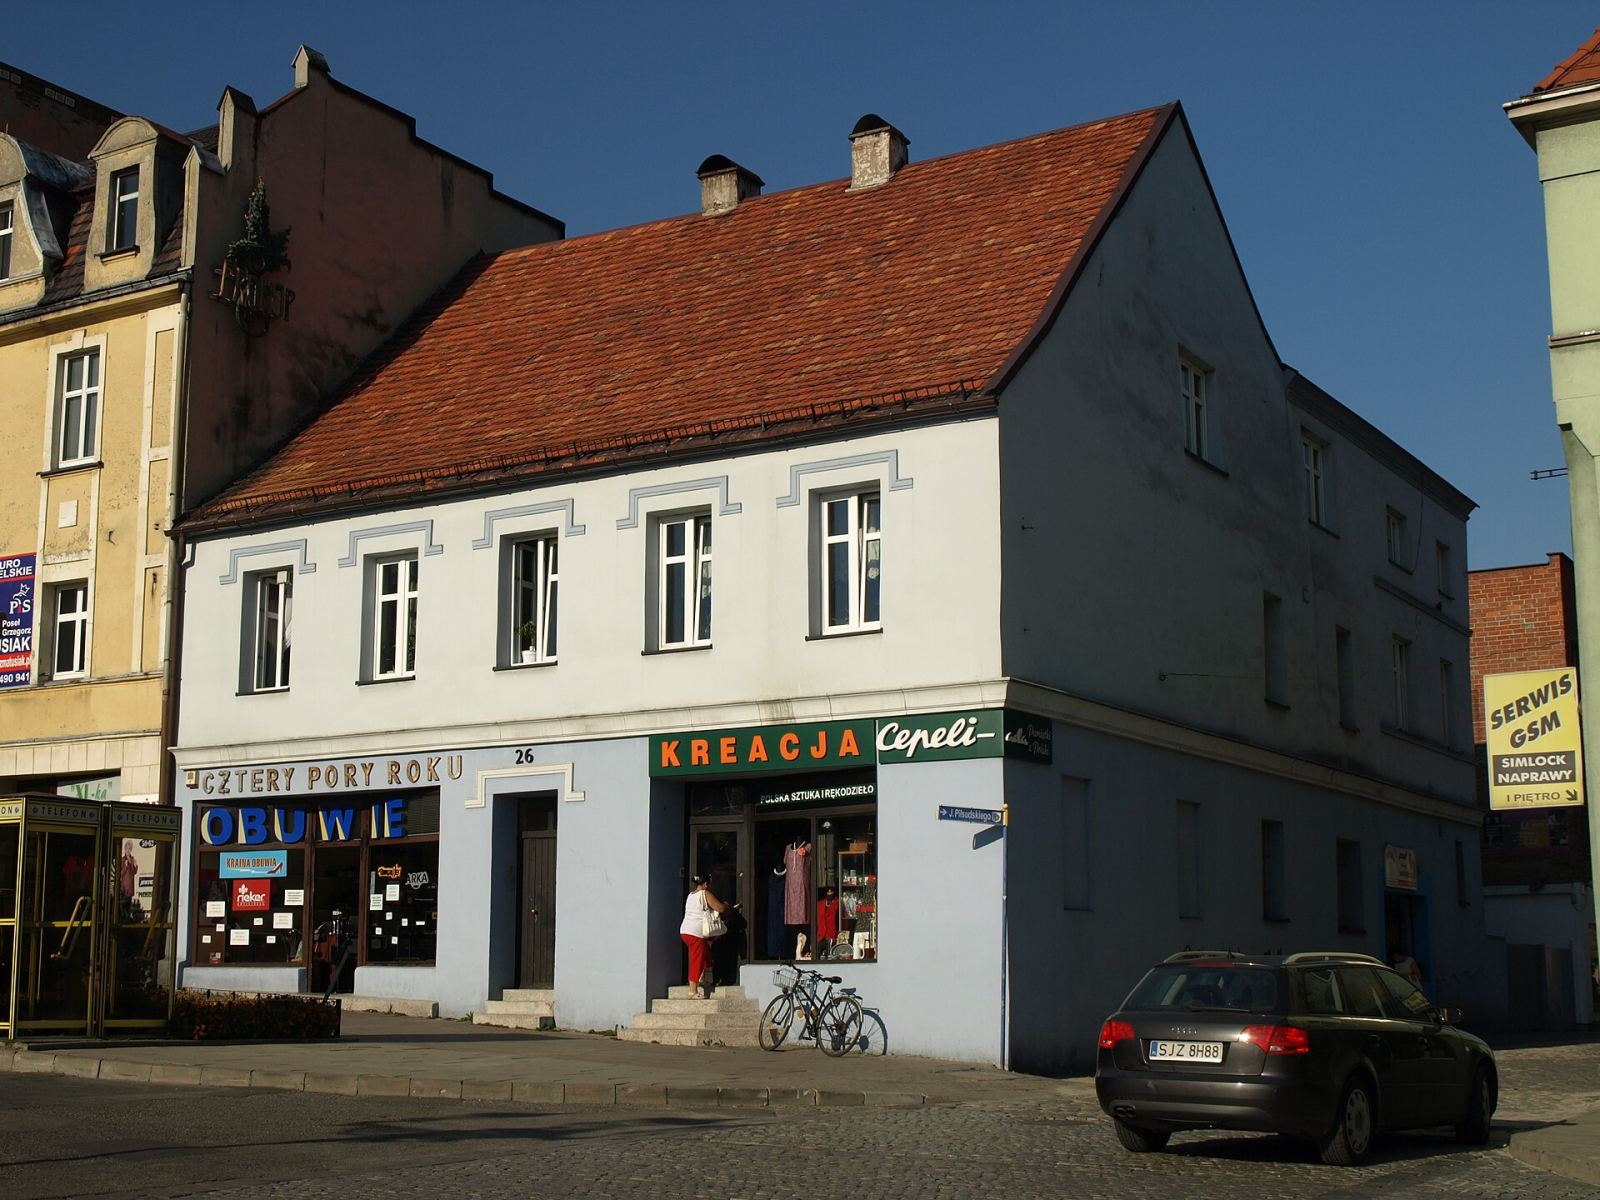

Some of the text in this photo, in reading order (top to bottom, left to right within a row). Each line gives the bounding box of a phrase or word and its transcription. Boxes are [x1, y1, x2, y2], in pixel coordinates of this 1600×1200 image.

[0, 637, 30, 653] SIAK
[15, 672, 30, 682] 941
[1490, 673, 1572, 730] SERWIS
[1509, 710, 1561, 749] GSM
[661, 728, 860, 768] KREACJA
[515, 748, 535, 765] 26
[1501, 754, 1567, 768] SIMLOCK
[202, 755, 463, 794] CZTERY PORY ROKU
[1497, 769, 1572, 784] NAPRAWY
[791, 790, 821, 801] SZTUKA
[821, 789, 825, 799] I
[825, 785, 874, 799] RĘKODZIEŁO
[1514, 791, 1561, 803] PIĘTRO
[41, 807, 88, 818] TELEFON
[126, 813, 168, 824] TELEFON
[201, 799, 406, 845] OBUWIE
[226, 857, 277, 868] KRAINA OBUWIA
[237, 891, 266, 902] rieker
[1159, 1044, 1219, 1058] SJZ 8H88
